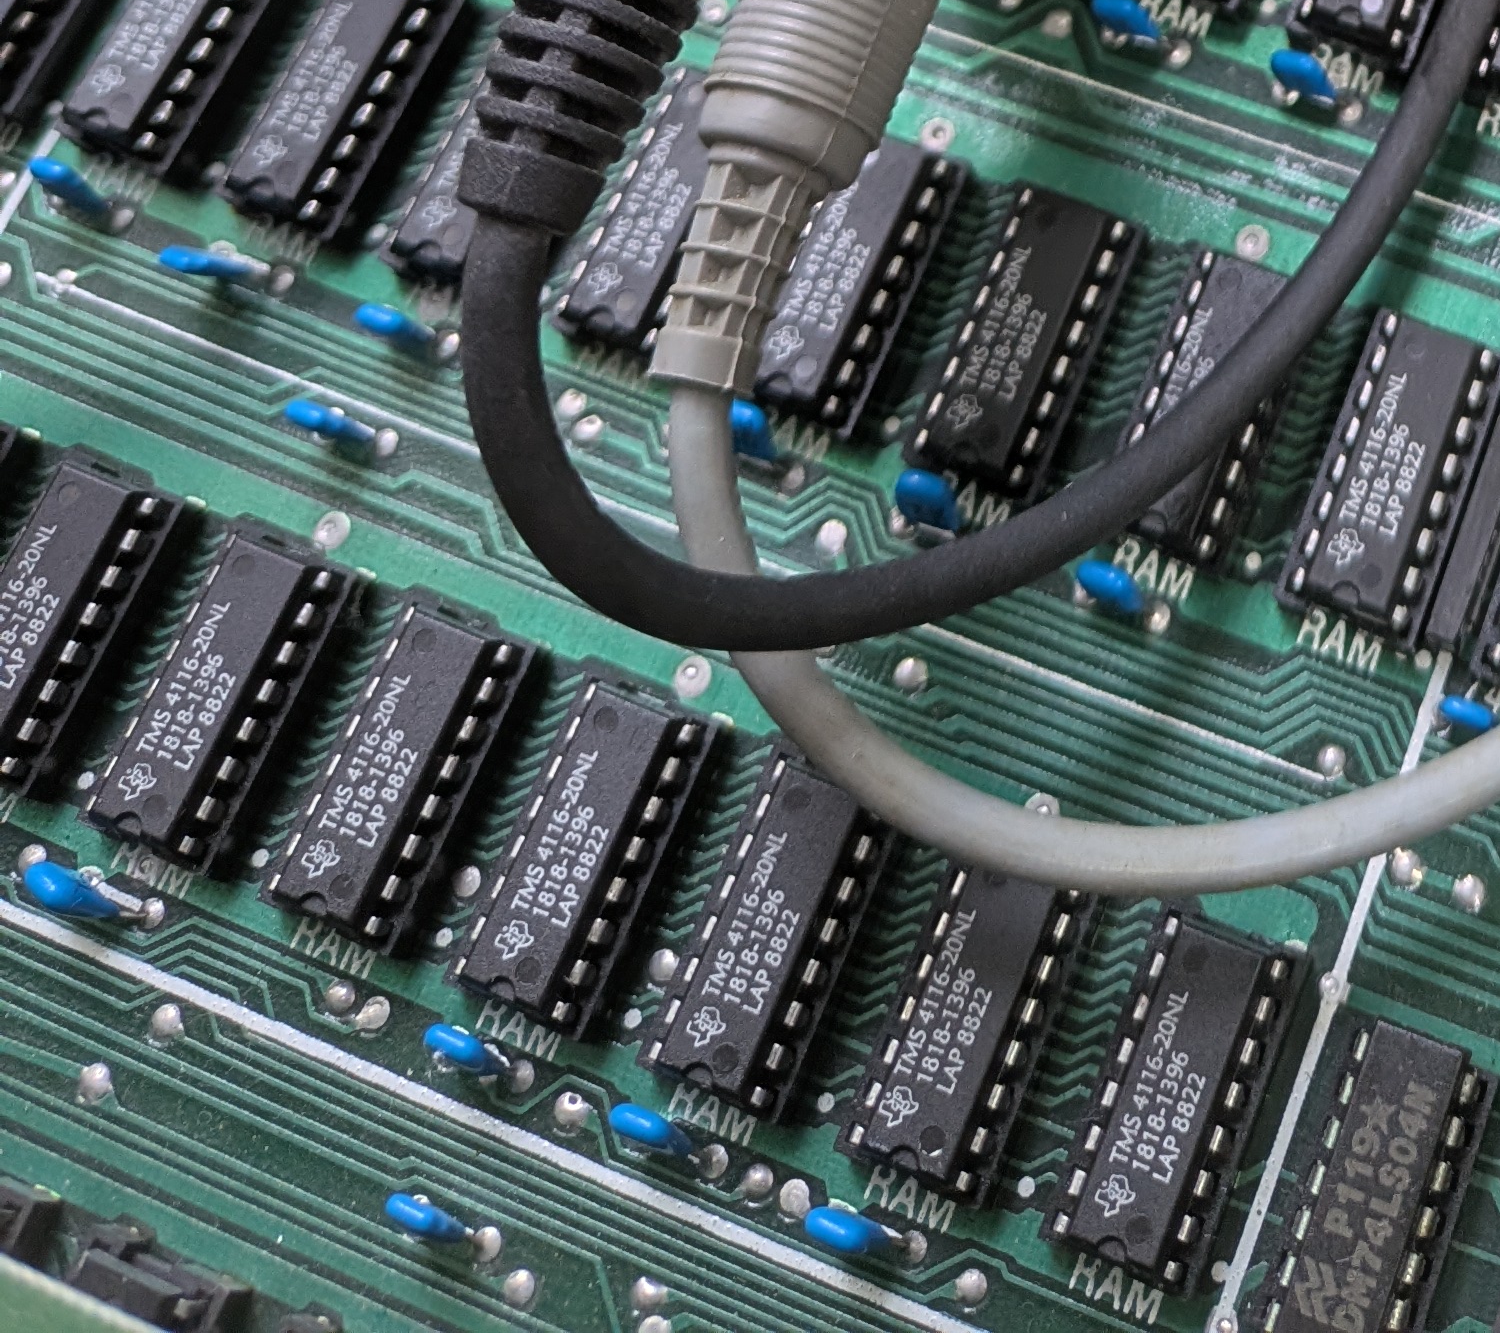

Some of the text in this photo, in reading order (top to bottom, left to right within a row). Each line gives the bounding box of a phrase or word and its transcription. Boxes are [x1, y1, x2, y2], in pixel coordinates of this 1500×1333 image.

[602, 208, 637, 257] TMS
[621, 164, 680, 263] 1818-1396
[638, 179, 693, 270] LAP 8822
[957, 343, 991, 389] TMS
[974, 290, 1038, 395] 1818-1396
[995, 307, 1051, 402] LAP 8822
[1338, 369, 1413, 522] TMS 4116-20NL
[1356, 422, 1417, 530] 1818-1396
[1377, 439, 1429, 536] LAP 8822
[19, 590, 61, 646] 8822
[1107, 534, 1198, 604] RAM
[134, 596, 234, 756] TMS 4116-20NL
[1294, 606, 1388, 674] RAM
[153, 651, 226, 763] 1818-1396
[172, 670, 237, 771] LAP 8822
[318, 668, 415, 833] TMS 4116-20NL
[334, 725, 409, 840] 1818-1396
[357, 745, 420, 849] LAP 8822
[507, 744, 605, 915] TMS 4116-20NL
[524, 802, 600, 920] 1818-1396
[547, 822, 612, 929] LAP 8822
[700, 826, 795, 1000] TMS 4116-20NL
[716, 885, 791, 1005] 1818-1396
[740, 906, 803, 1015] LAP 8822
[891, 905, 982, 1079] TMS 4116-20NL
[909, 964, 981, 1085] 1818-1396
[932, 984, 995, 1095] LAP 8822
[1106, 985, 1197, 1166] TMS 4116-20NL
[1124, 1048, 1196, 1172] 1818-1396
[1147, 1070, 1210, 1182] LAP 8822
